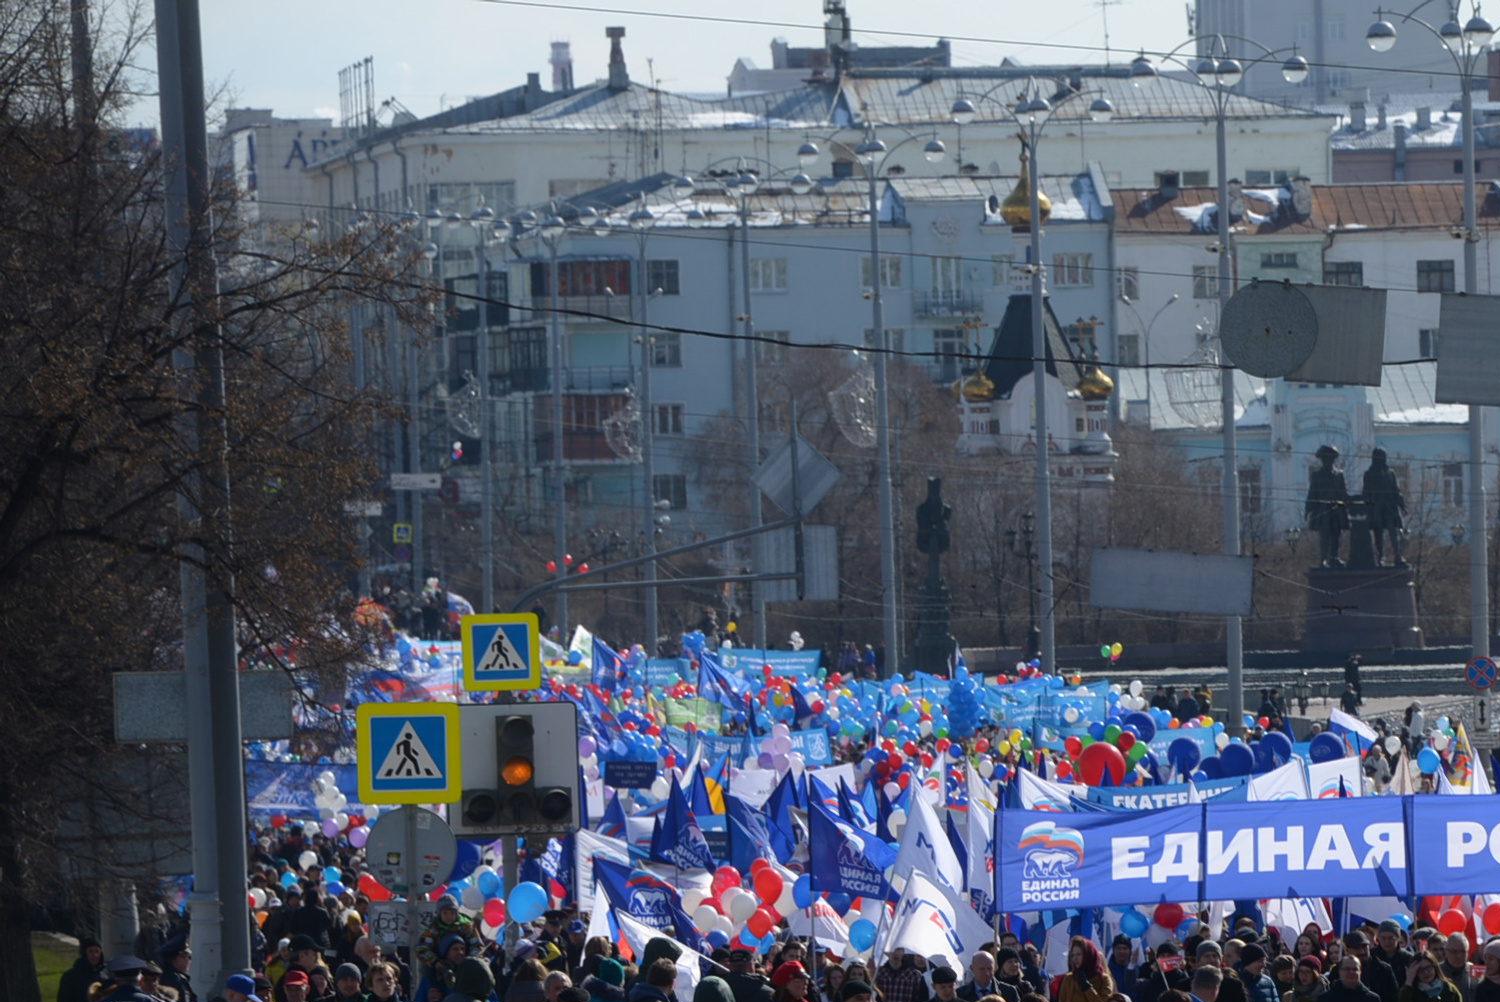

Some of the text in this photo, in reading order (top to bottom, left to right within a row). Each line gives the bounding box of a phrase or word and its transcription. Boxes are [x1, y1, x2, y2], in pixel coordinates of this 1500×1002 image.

[1111, 822, 1406, 884] ЕДИНАЯ
[1021, 878, 1080, 891] ЕДИНАЯ
[1022, 890, 1080, 903] РОССИЯ
